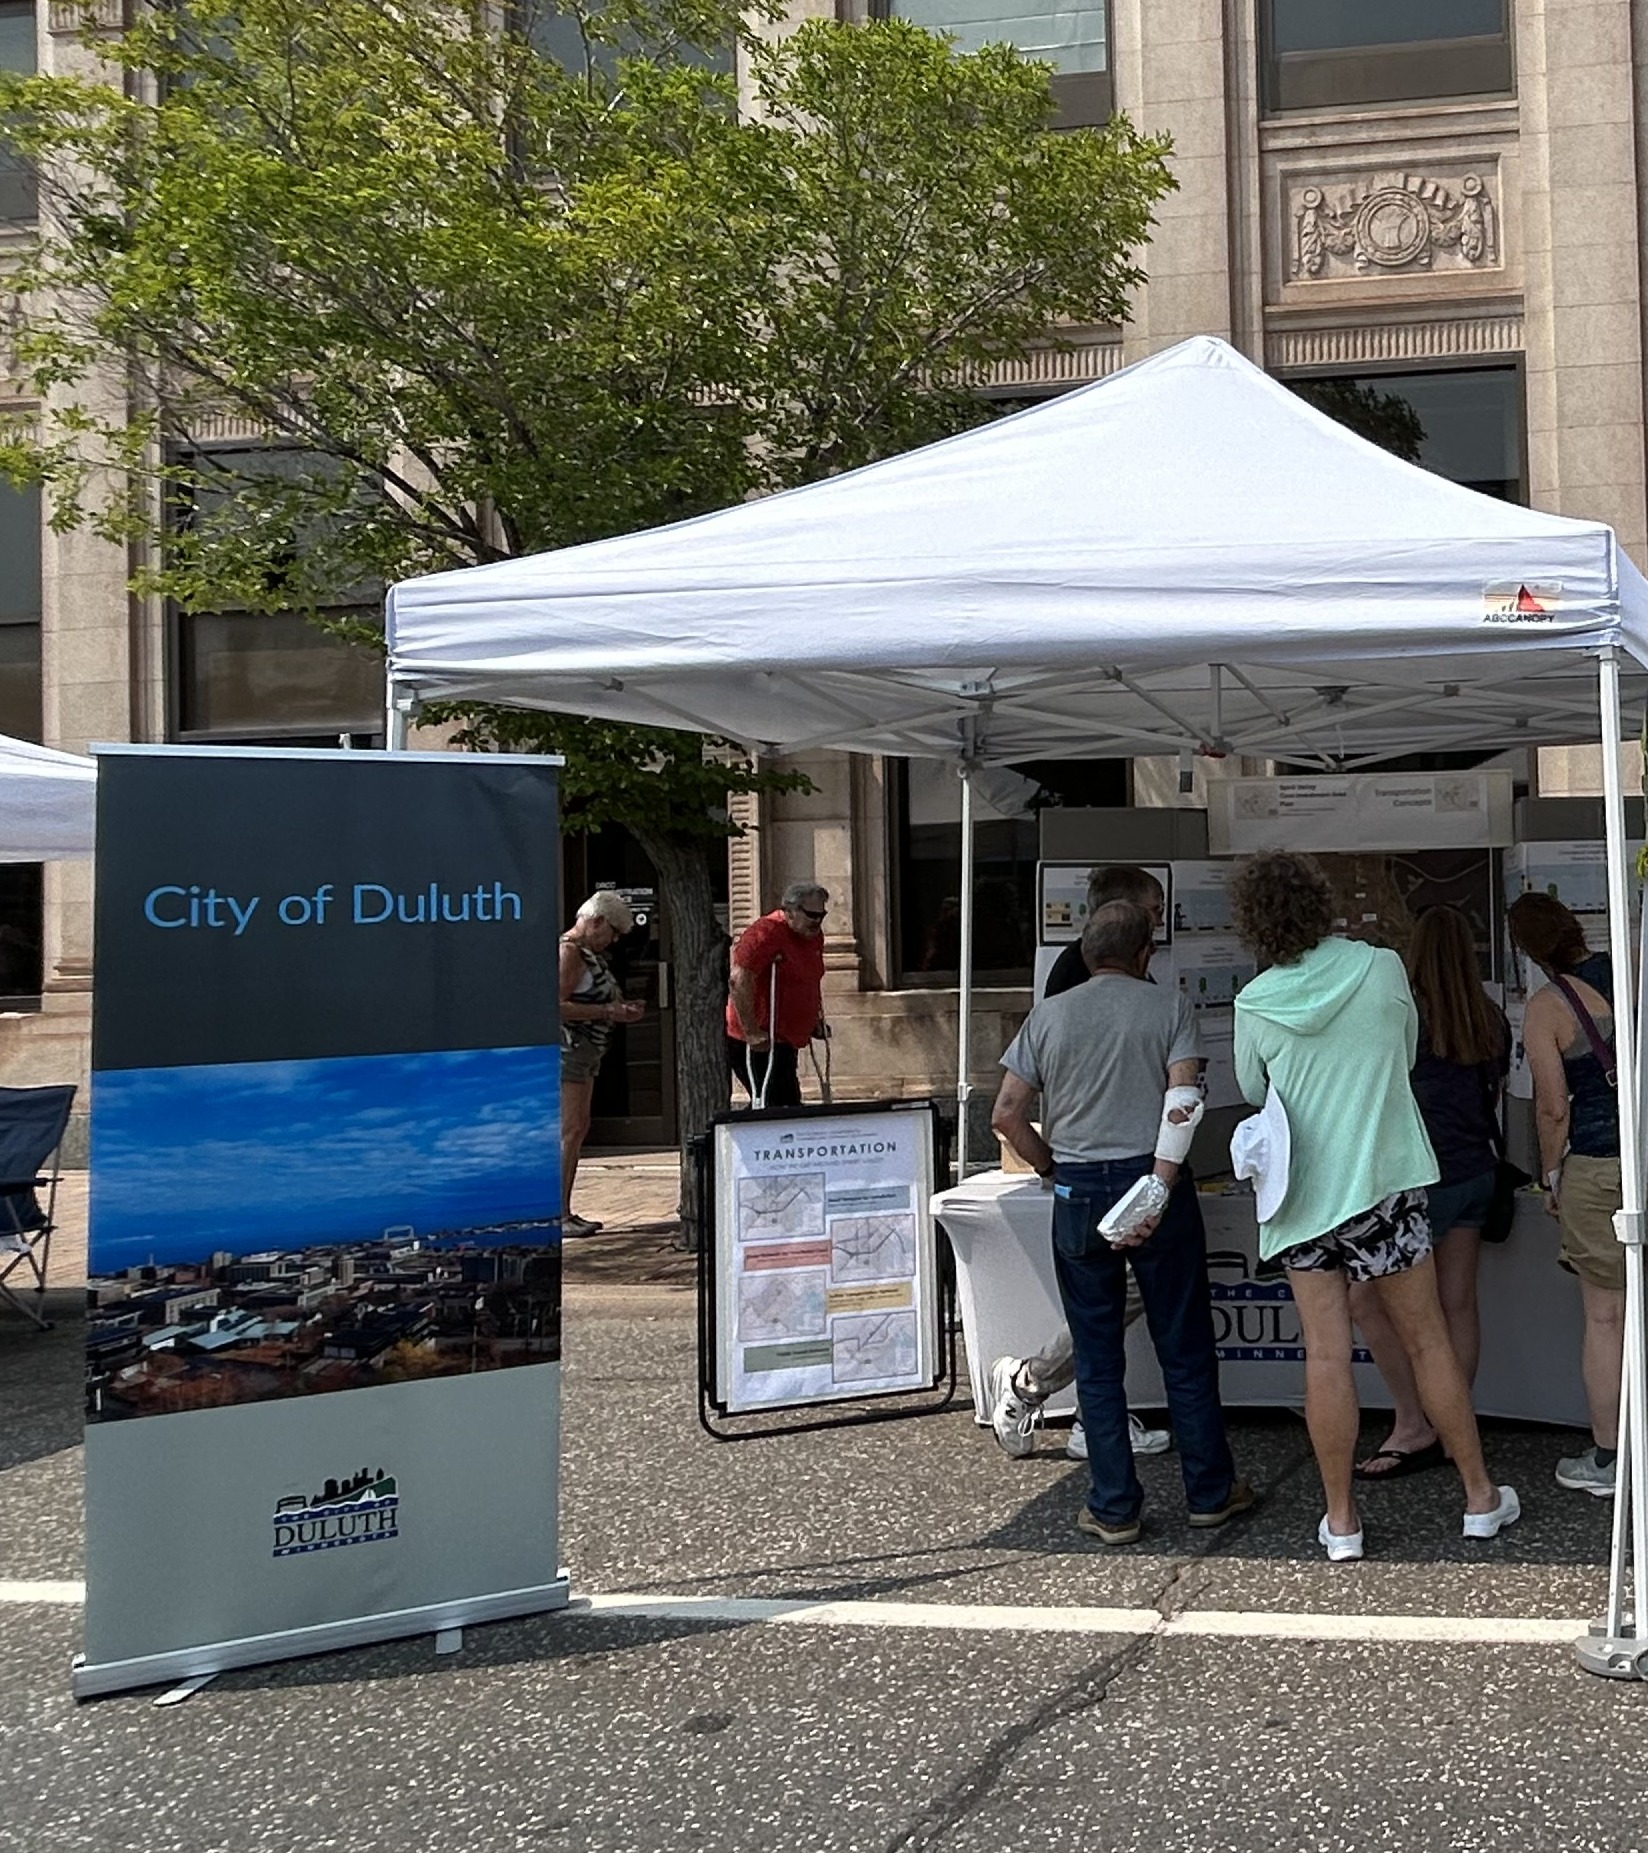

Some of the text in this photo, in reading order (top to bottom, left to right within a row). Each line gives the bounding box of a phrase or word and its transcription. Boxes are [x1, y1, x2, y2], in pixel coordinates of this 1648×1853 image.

[1483, 613, 1555, 623] ABCCANOPY
[144, 882, 524, 936] City of Duluth
[753, 1142, 897, 1161] TRANSPORTATION
[1210, 1288, 1253, 1299] THE
[1210, 1305, 1301, 1344] DUL
[1215, 1349, 1368, 1360] MINNET
[274, 1508, 398, 1548] DULUTH
